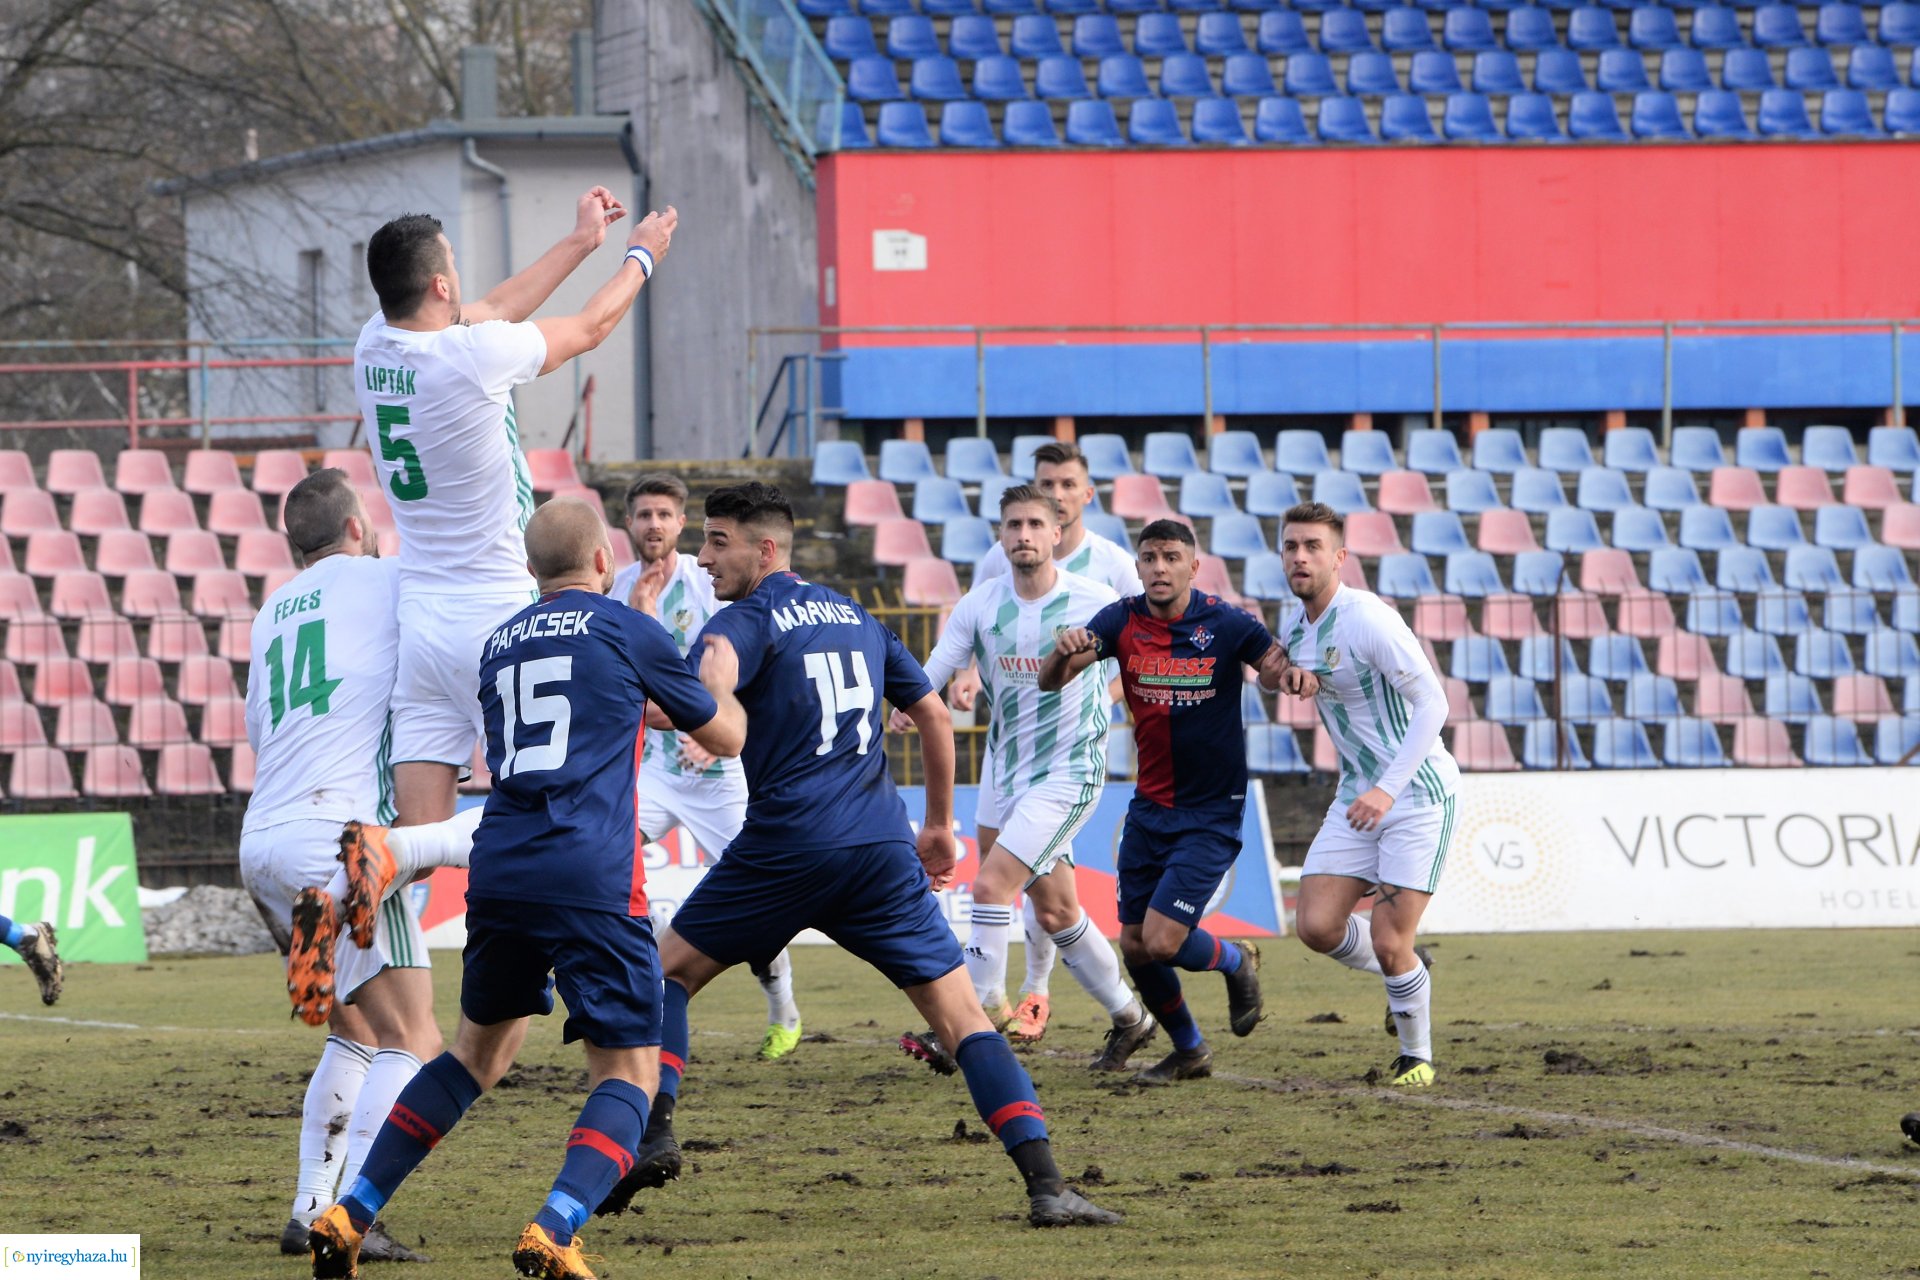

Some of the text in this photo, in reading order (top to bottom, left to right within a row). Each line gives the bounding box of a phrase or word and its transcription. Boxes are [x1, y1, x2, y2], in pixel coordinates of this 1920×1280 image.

[365, 365, 416, 395] LIPTÁK
[376, 404, 428, 501] 5
[274, 589, 321, 625] FEJES
[771, 599, 861, 632] MÁRKUS
[489, 611, 594, 659] PAPUCSEK
[264, 618, 344, 735] 14
[495, 655, 573, 781] 15
[803, 651, 874, 756] 14
[1482, 841, 1524, 869] VG
[1173, 899, 1196, 914] JAKO
